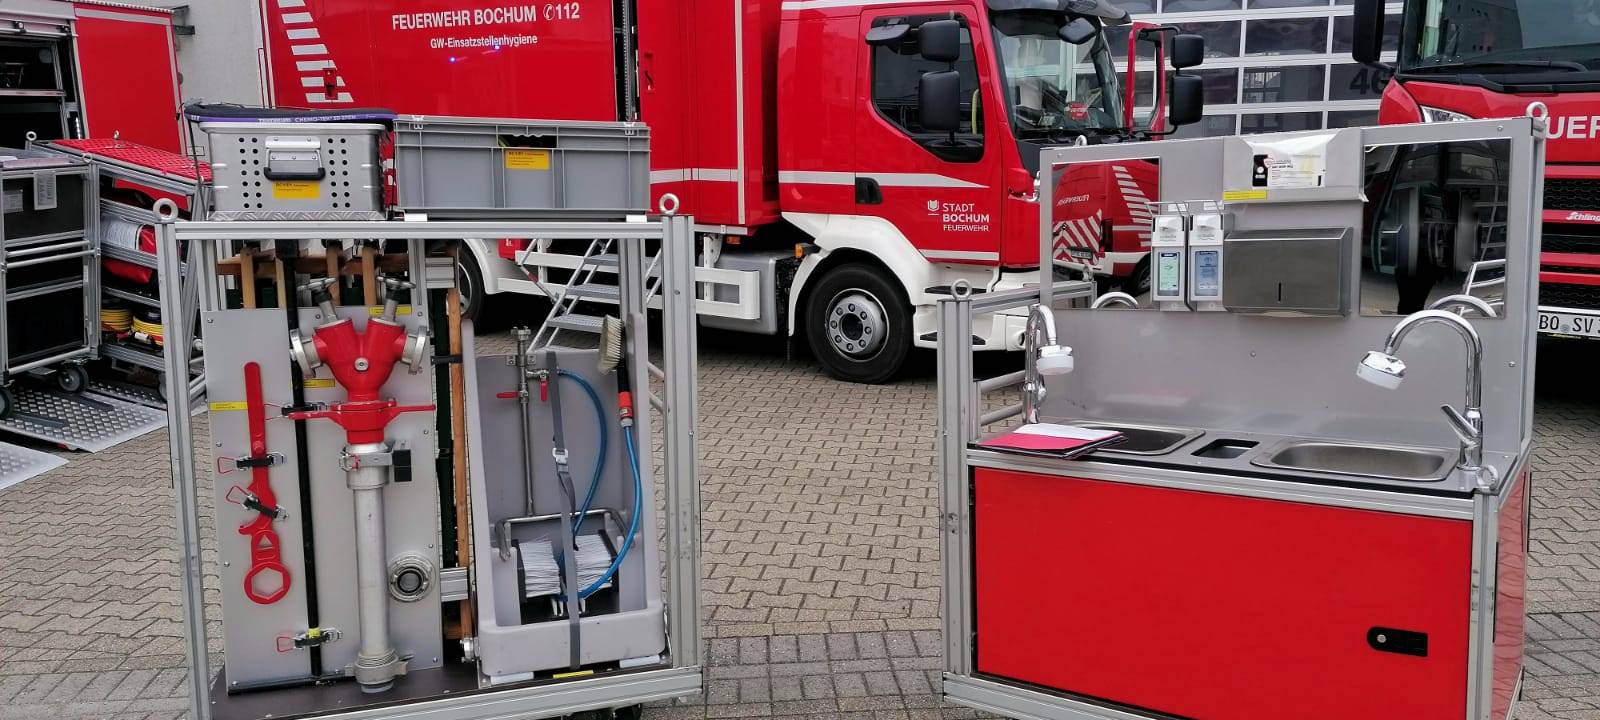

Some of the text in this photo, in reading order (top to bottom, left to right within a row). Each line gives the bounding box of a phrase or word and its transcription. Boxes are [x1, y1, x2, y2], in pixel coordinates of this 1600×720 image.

[392, 10, 470, 30] FEUERWEHR
[474, 5, 536, 24] BOCHUM
[430, 33, 538, 49] GW-Einsatzstellenhygiene
[942, 203, 975, 212] STADT
[942, 213, 990, 223] BOCHUM
[943, 224, 989, 232] FEUERWEHR
[1539, 314, 1594, 333] BO SV
